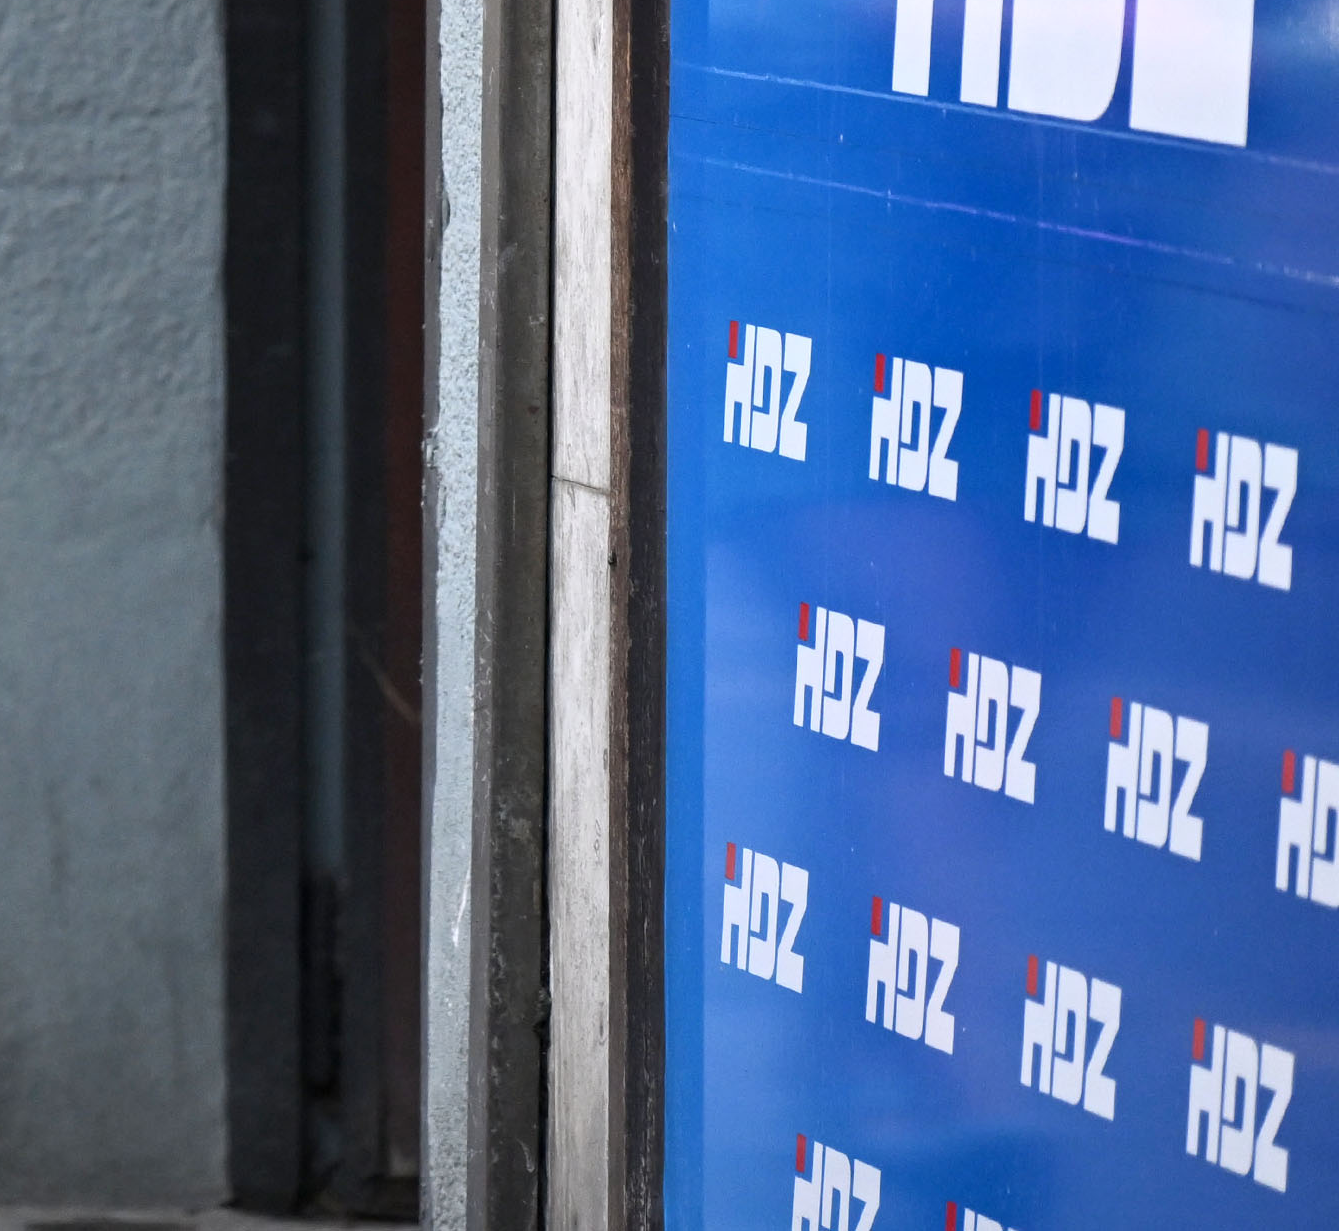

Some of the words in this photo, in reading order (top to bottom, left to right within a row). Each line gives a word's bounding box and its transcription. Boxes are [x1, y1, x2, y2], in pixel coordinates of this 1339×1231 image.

[724, 320, 812, 461] HDZ
[869, 353, 963, 501] HDZ
[1025, 389, 1125, 544] HDZ
[1189, 428, 1298, 591] HDZ
[793, 602, 885, 751] HDZ
[944, 648, 1041, 804] HDZ
[1104, 697, 1208, 861] HDZ
[1276, 749, 1339, 907] HD
[721, 842, 809, 993] HDZ
[866, 896, 960, 1054] HDZ
[1021, 954, 1122, 1121] HDZ
[1186, 1017, 1295, 1193] HDZ
